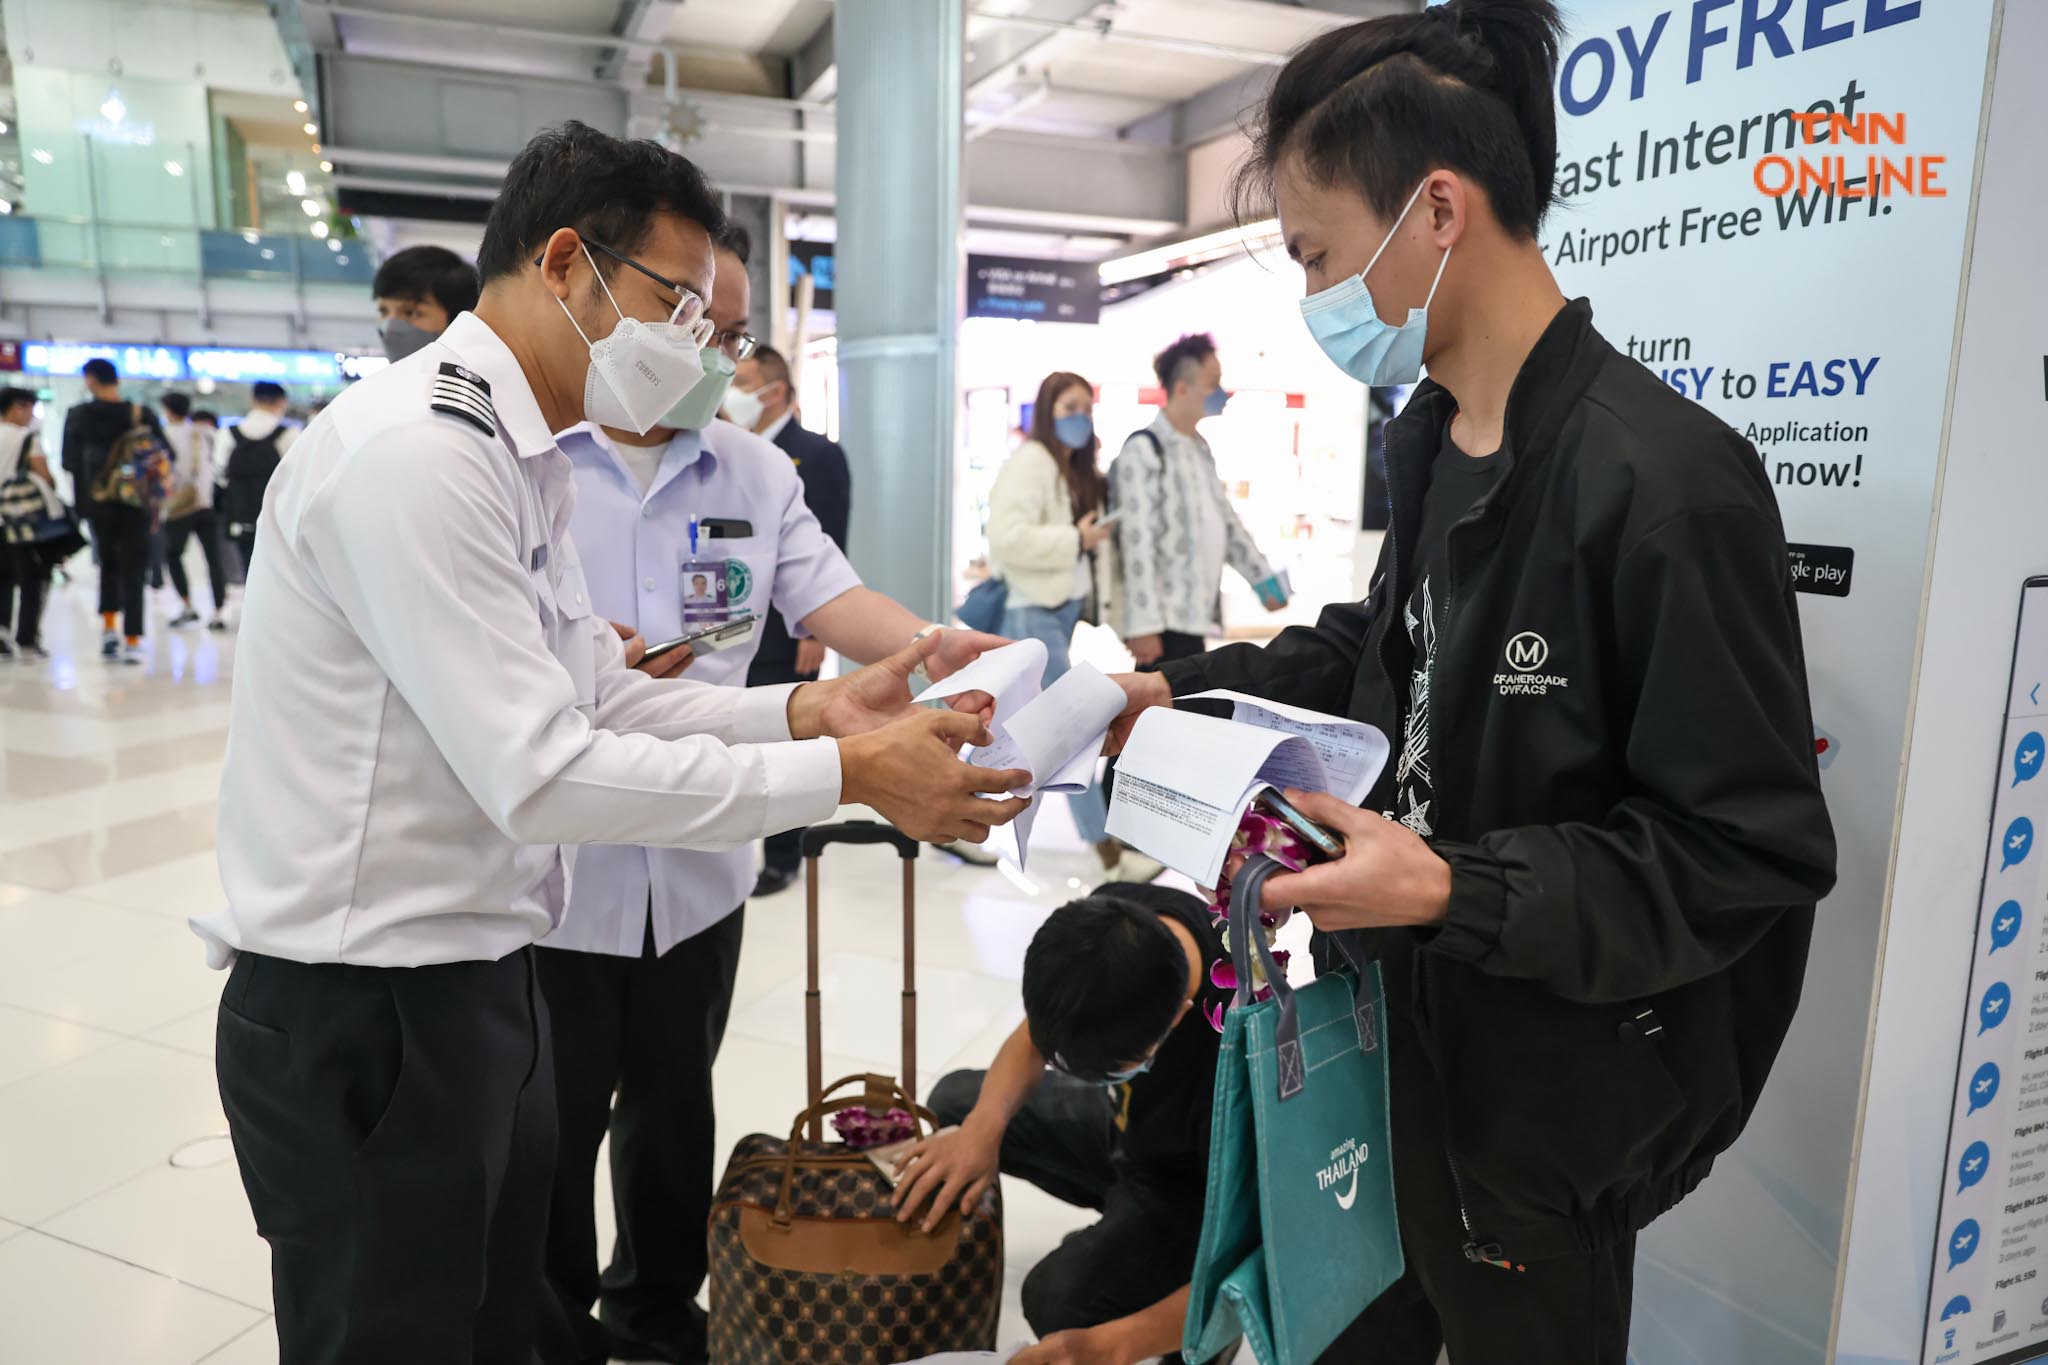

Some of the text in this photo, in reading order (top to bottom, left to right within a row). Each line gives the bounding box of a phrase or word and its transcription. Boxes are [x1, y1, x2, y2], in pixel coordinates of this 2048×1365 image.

[1556, 79, 1865, 198] ast Internet
[1554, 215, 1671, 267] Airport
[1679, 206, 1762, 247] Free
[1626, 334, 1691, 363] turn
[1721, 368, 1757, 400] to
[1766, 356, 1880, 398] EASY
[1744, 420, 1868, 446] Application
[1775, 453, 1863, 488] now!
[1814, 563, 1847, 585] play
[1514, 640, 1540, 663] M
[1315, 1142, 1368, 1191] THAILAND
[2004, 1202, 2023, 1215] Flight
[1994, 1277, 2014, 1290] Flight
